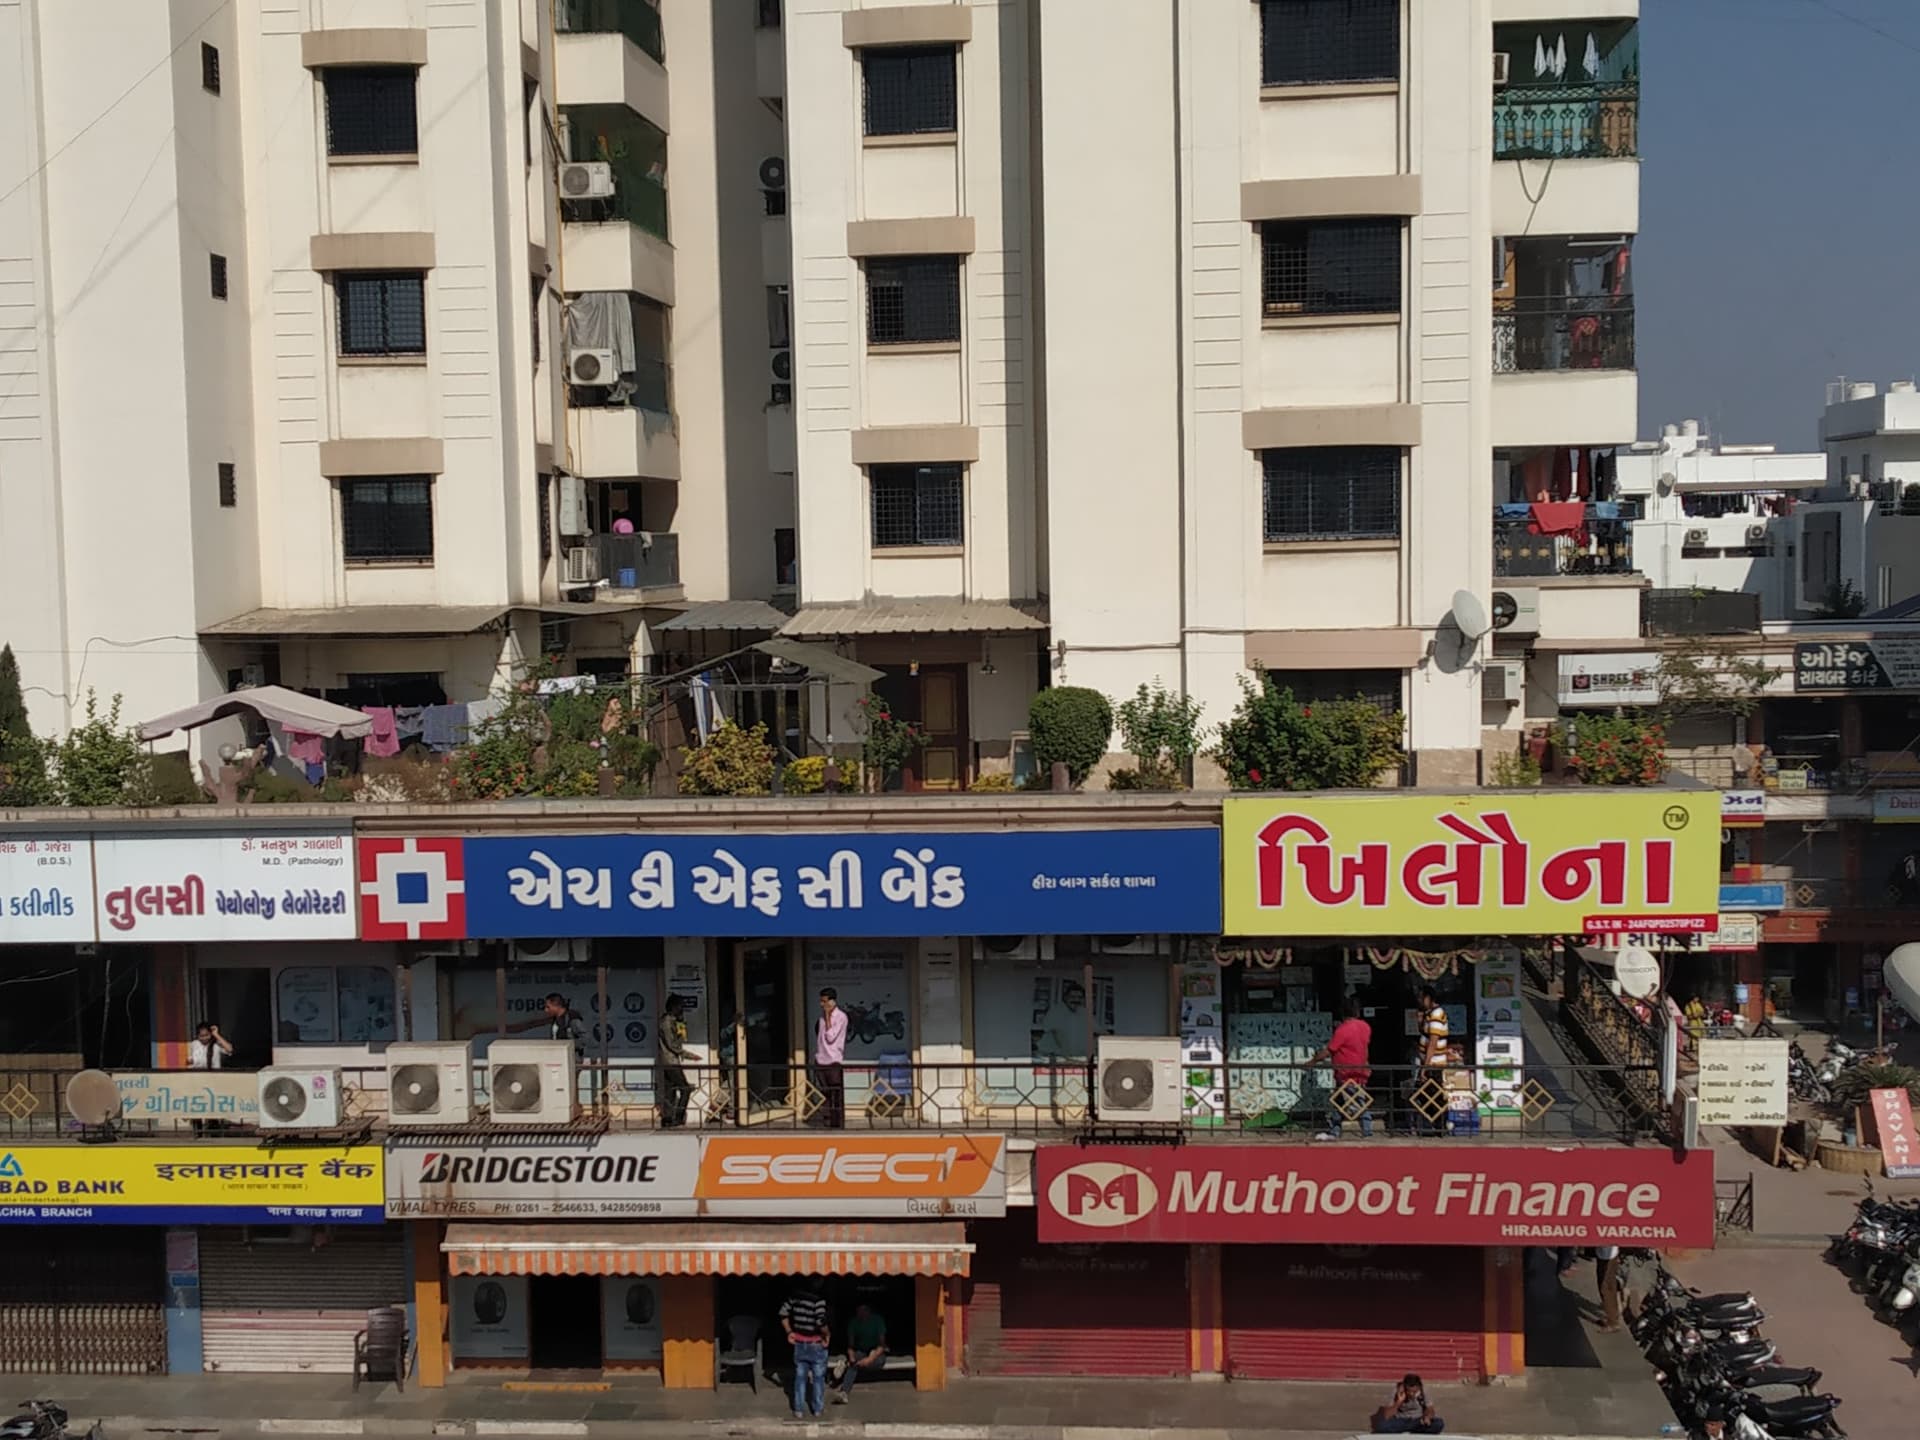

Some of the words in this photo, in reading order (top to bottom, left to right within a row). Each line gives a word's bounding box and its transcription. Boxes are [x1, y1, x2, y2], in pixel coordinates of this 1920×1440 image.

[261, 840, 298, 854] મનસુખ
[287, 856, 344, 866] (Pathology)
[507, 850, 612, 909] એચ
[629, 850, 676, 909] ડી
[691, 849, 783, 917] એફ
[798, 850, 863, 908] સી
[1059, 876, 1086, 889] બાગ
[1123, 876, 1156, 888] શાખા
[105, 874, 205, 931] તુલસી
[215, 889, 276, 920] પેથોલોજી
[281, 888, 347, 915] લેબોરેટરી
[154, 1163, 308, 1181] इलाहाबाद
[320, 1158, 375, 1178] बैंक
[420, 1153, 660, 1184] BRIDGESTONE
[57, 1180, 125, 1194] BANK
[1168, 1171, 1417, 1215] Muthoot
[1435, 1173, 1660, 1217] Finance
[41, 1207, 92, 1217] BRANCH
[389, 1202, 428, 1213] VIMAL
[433, 1202, 477, 1213] TYRES
[516, 1203, 540, 1213] 0261
[907, 1198, 941, 1213] વિમલ
[1501, 1225, 1587, 1238] HIRABAUG
[1597, 1225, 1676, 1239] VARACHA
